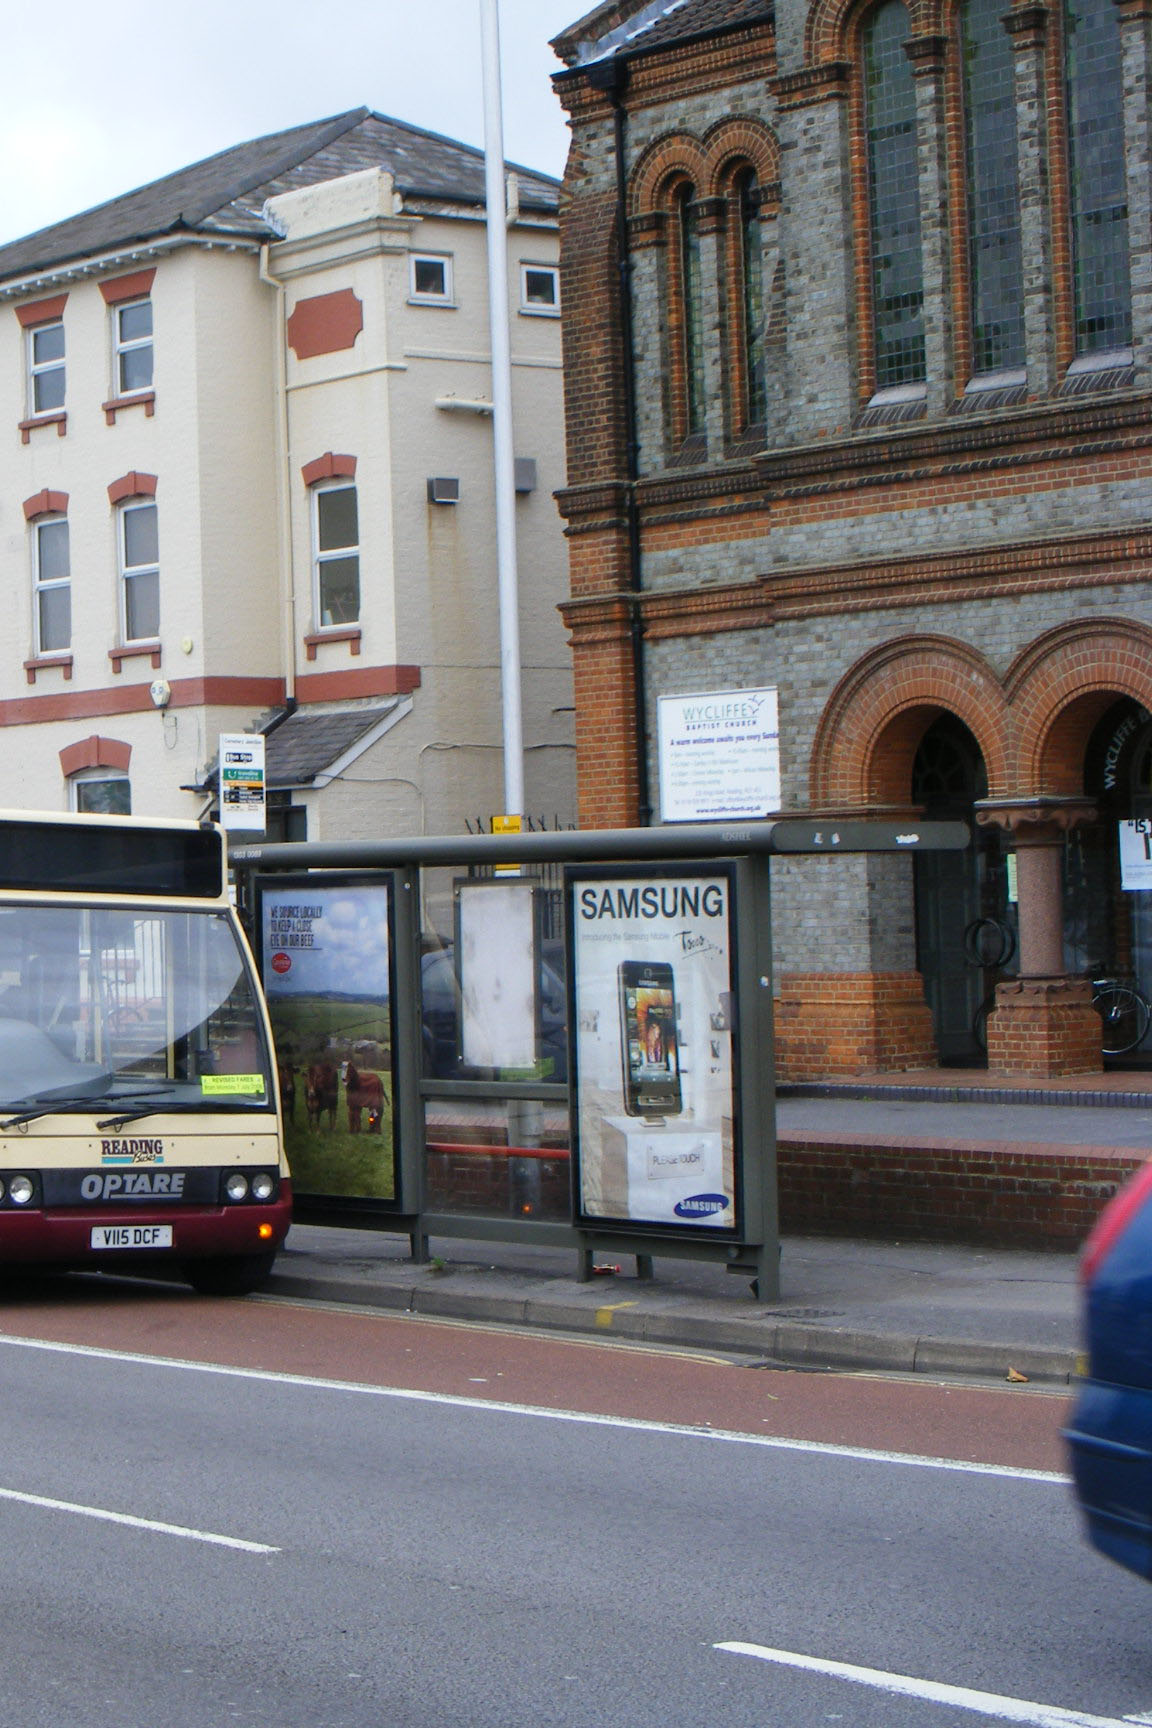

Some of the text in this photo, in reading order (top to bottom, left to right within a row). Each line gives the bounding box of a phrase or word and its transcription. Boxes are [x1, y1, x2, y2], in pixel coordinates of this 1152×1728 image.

[683, 703, 748, 720] WYCLIFFE
[686, 720, 757, 731] BAPTIST CHURCH
[692, 736, 715, 744] welcome
[762, 731, 780, 740] Sunda
[1104, 718, 1137, 790] WYCLIFFE
[581, 885, 723, 919] SAMSUNG
[279, 906, 299, 918] SOURCE
[301, 934, 314, 947] BEEF
[101, 1139, 163, 1155] READING
[132, 1151, 156, 1163] Buses
[653, 1153, 700, 1166] PLEASE TOUCH
[81, 1173, 186, 1200] OPTARE
[680, 1200, 724, 1212] SAMSUNG
[104, 1228, 160, 1245] V115 DCF
